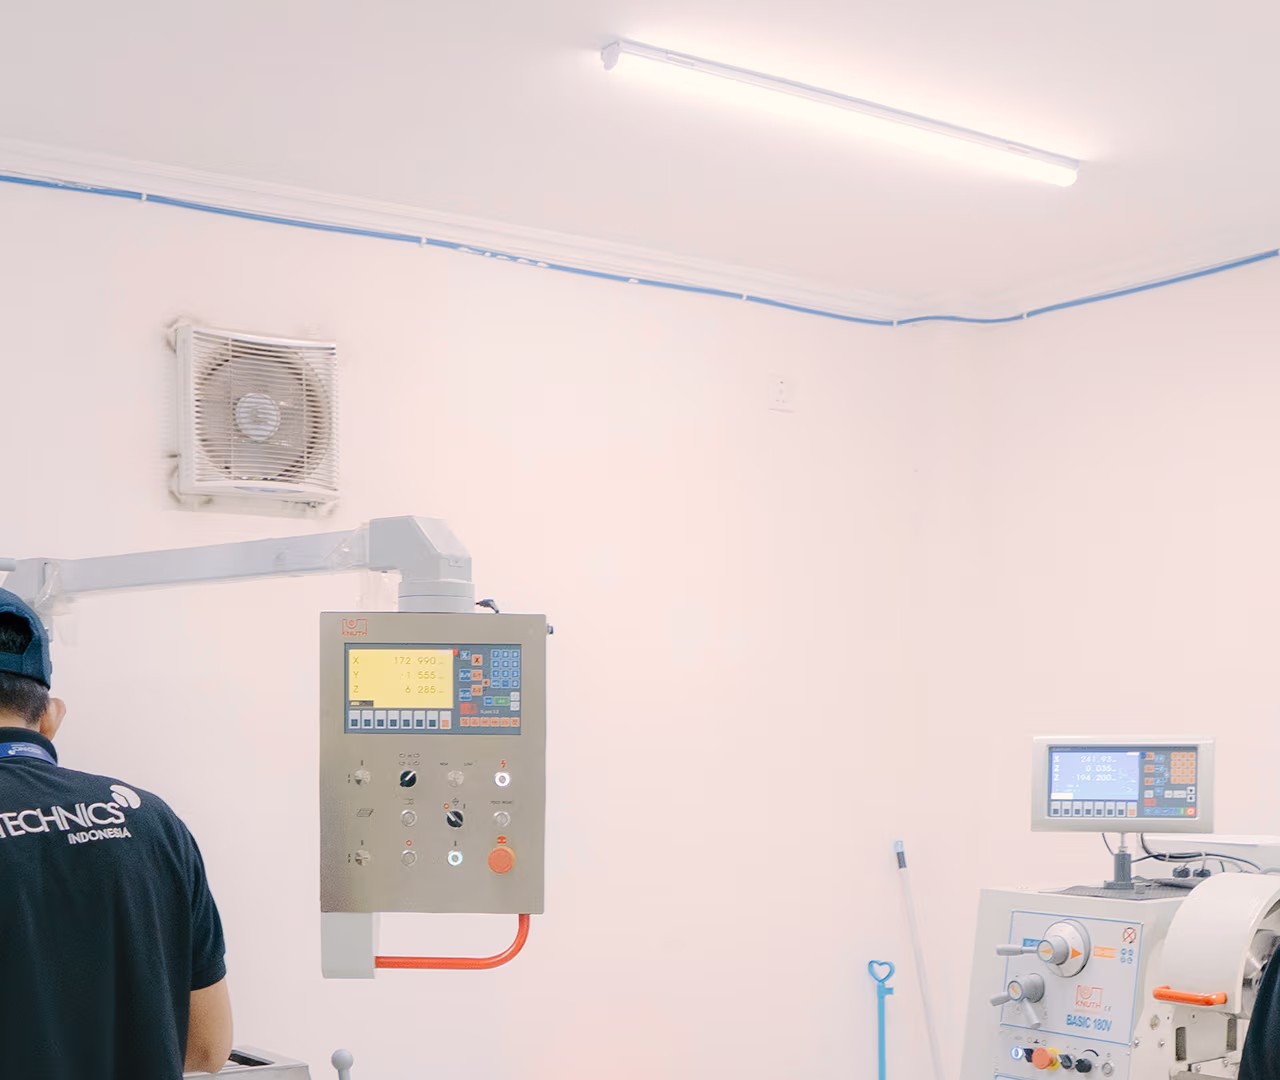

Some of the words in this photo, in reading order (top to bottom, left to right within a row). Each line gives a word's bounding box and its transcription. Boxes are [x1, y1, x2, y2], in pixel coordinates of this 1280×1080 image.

[352, 656, 360, 665] X
[352, 671, 360, 679] Y
[352, 685, 360, 693] Z
[67, 827, 132, 845] INDONESIA
[1066, 1014, 1092, 1029] BASIC
[1093, 1018, 1113, 1032] 180V
